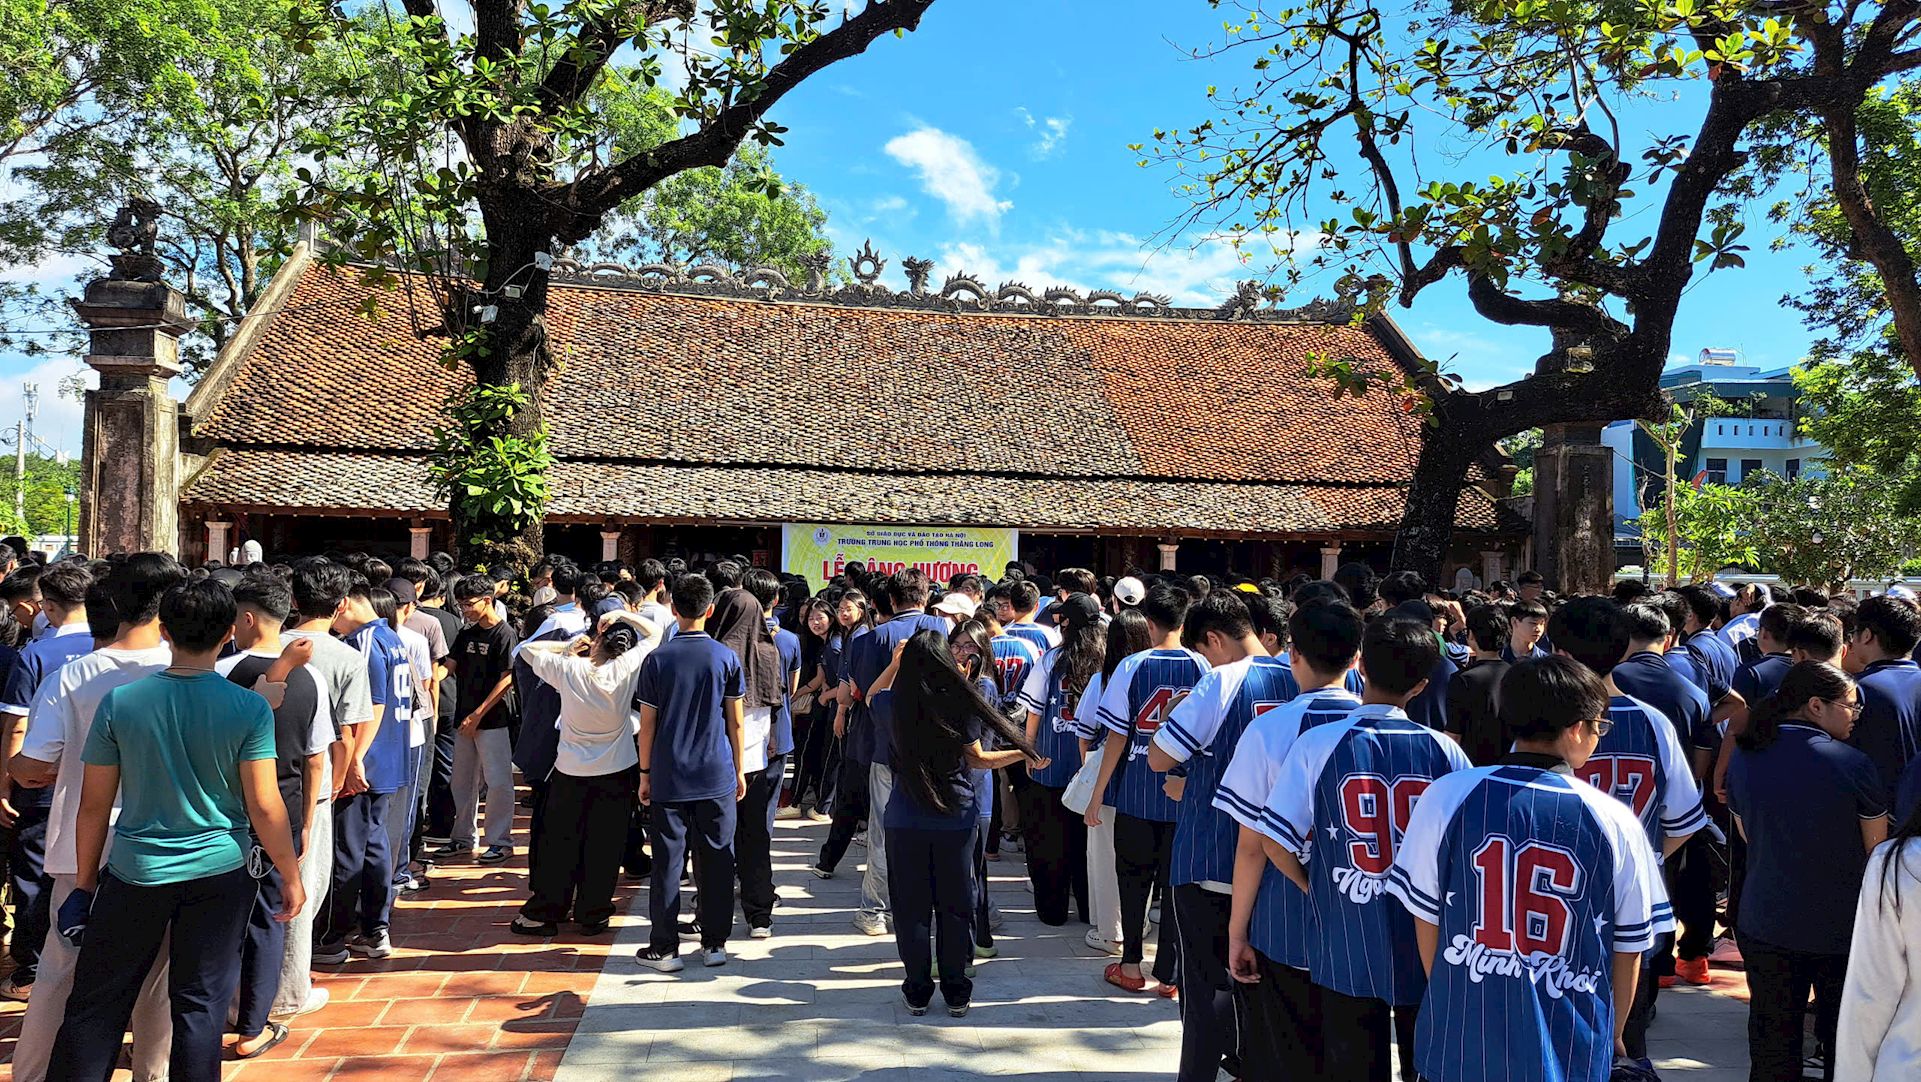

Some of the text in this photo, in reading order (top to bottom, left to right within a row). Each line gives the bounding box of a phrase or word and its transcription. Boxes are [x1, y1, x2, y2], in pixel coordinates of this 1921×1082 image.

[893, 540, 908, 548] HỌC
[1135, 686, 1192, 736] 4
[1332, 866, 1388, 904] Ngọ
[1472, 835, 1586, 966] 16
[1443, 933, 1602, 999] Minh Khôi
